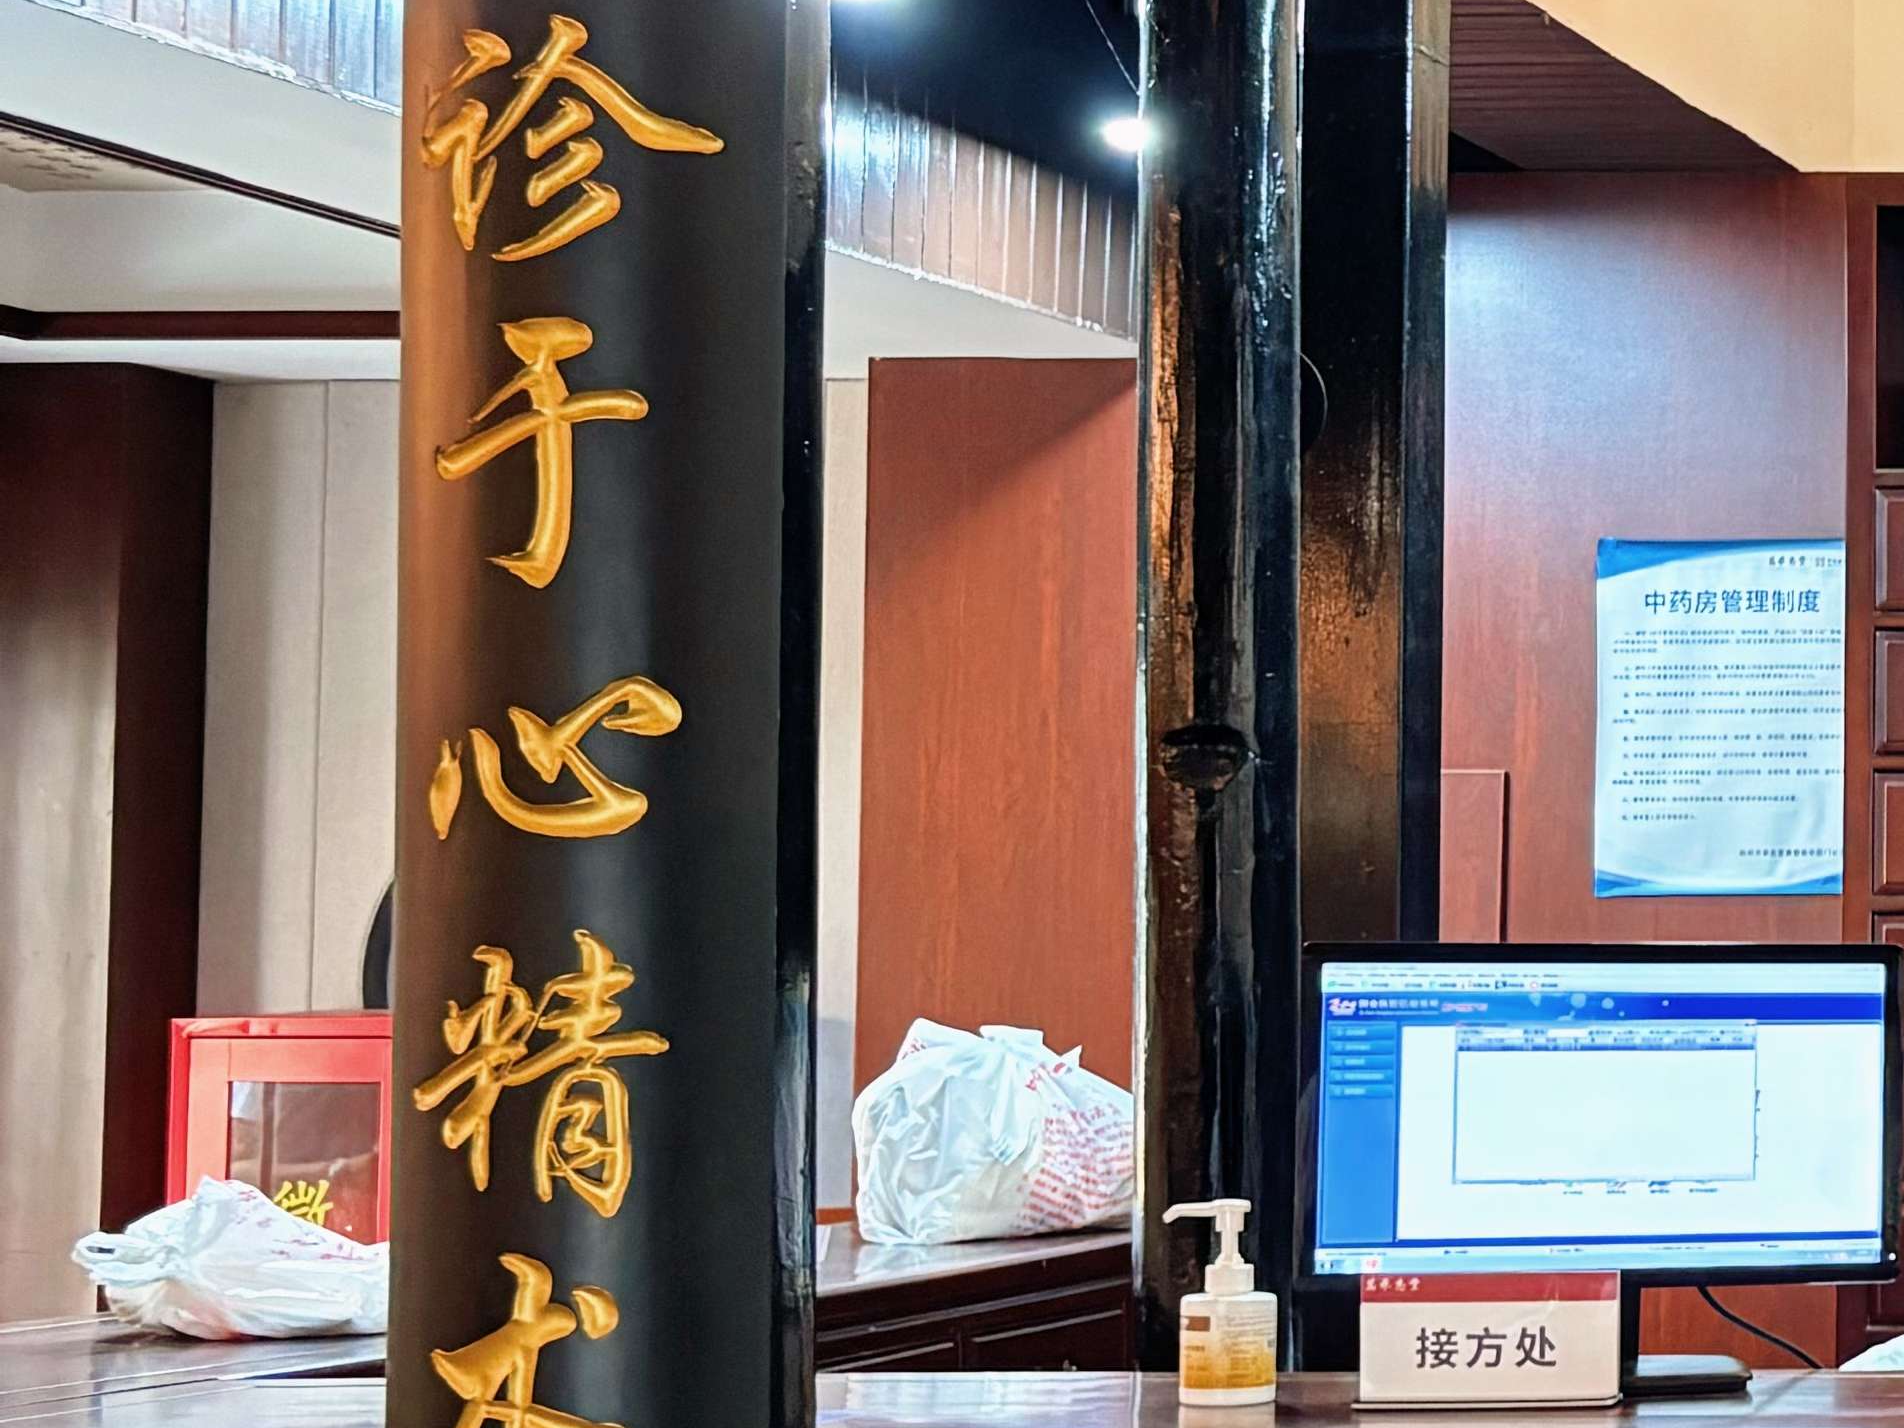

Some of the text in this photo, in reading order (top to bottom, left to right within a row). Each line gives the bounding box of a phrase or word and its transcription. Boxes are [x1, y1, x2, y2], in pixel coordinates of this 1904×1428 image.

[1645, 589, 1821, 614] 中药房管理制度
[1416, 1326, 1557, 1369] 接方处
